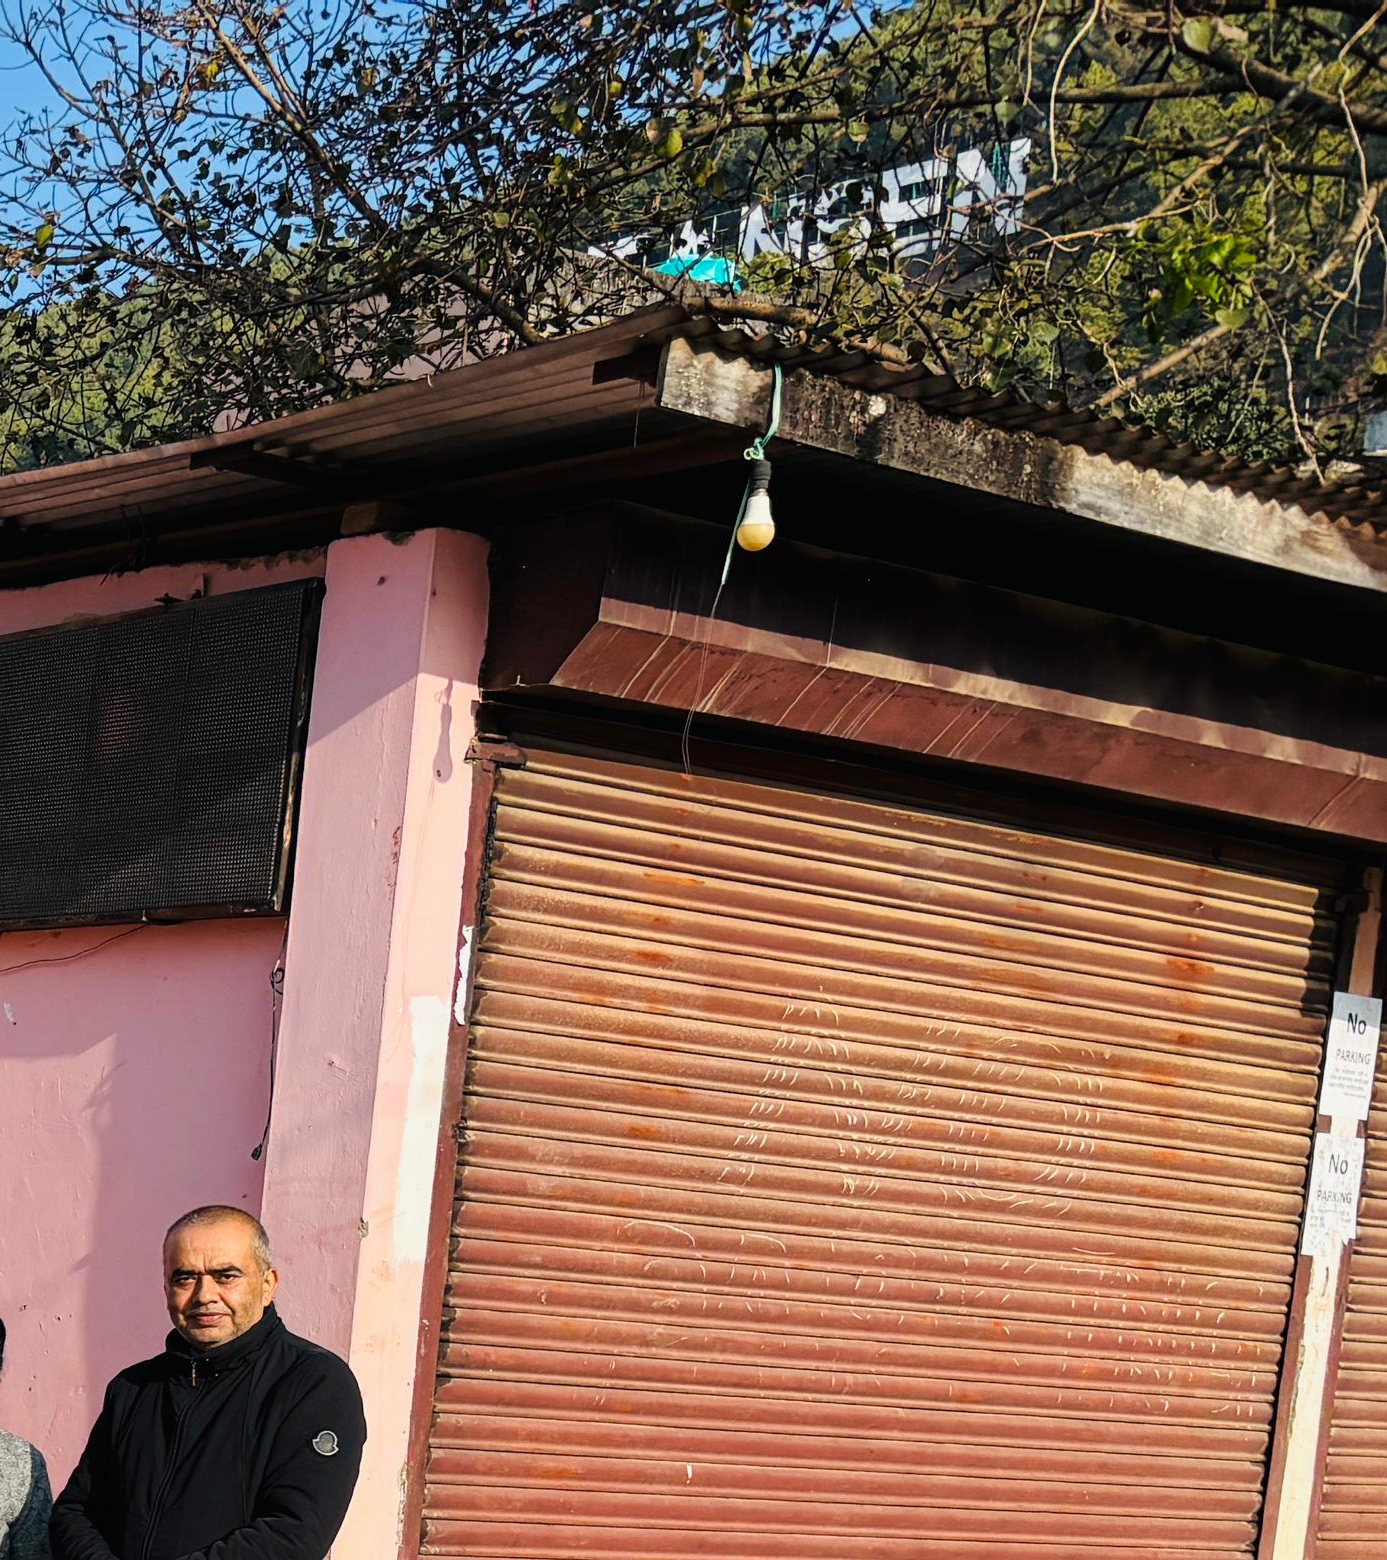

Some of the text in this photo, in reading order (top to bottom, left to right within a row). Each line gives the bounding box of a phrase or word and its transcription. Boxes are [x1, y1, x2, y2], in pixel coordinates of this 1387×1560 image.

[1346, 1012, 1367, 1035] No
[1335, 1048, 1371, 1065] PARKING
[1328, 1153, 1349, 1175] No
[1316, 1189, 1353, 1204] PARKING
